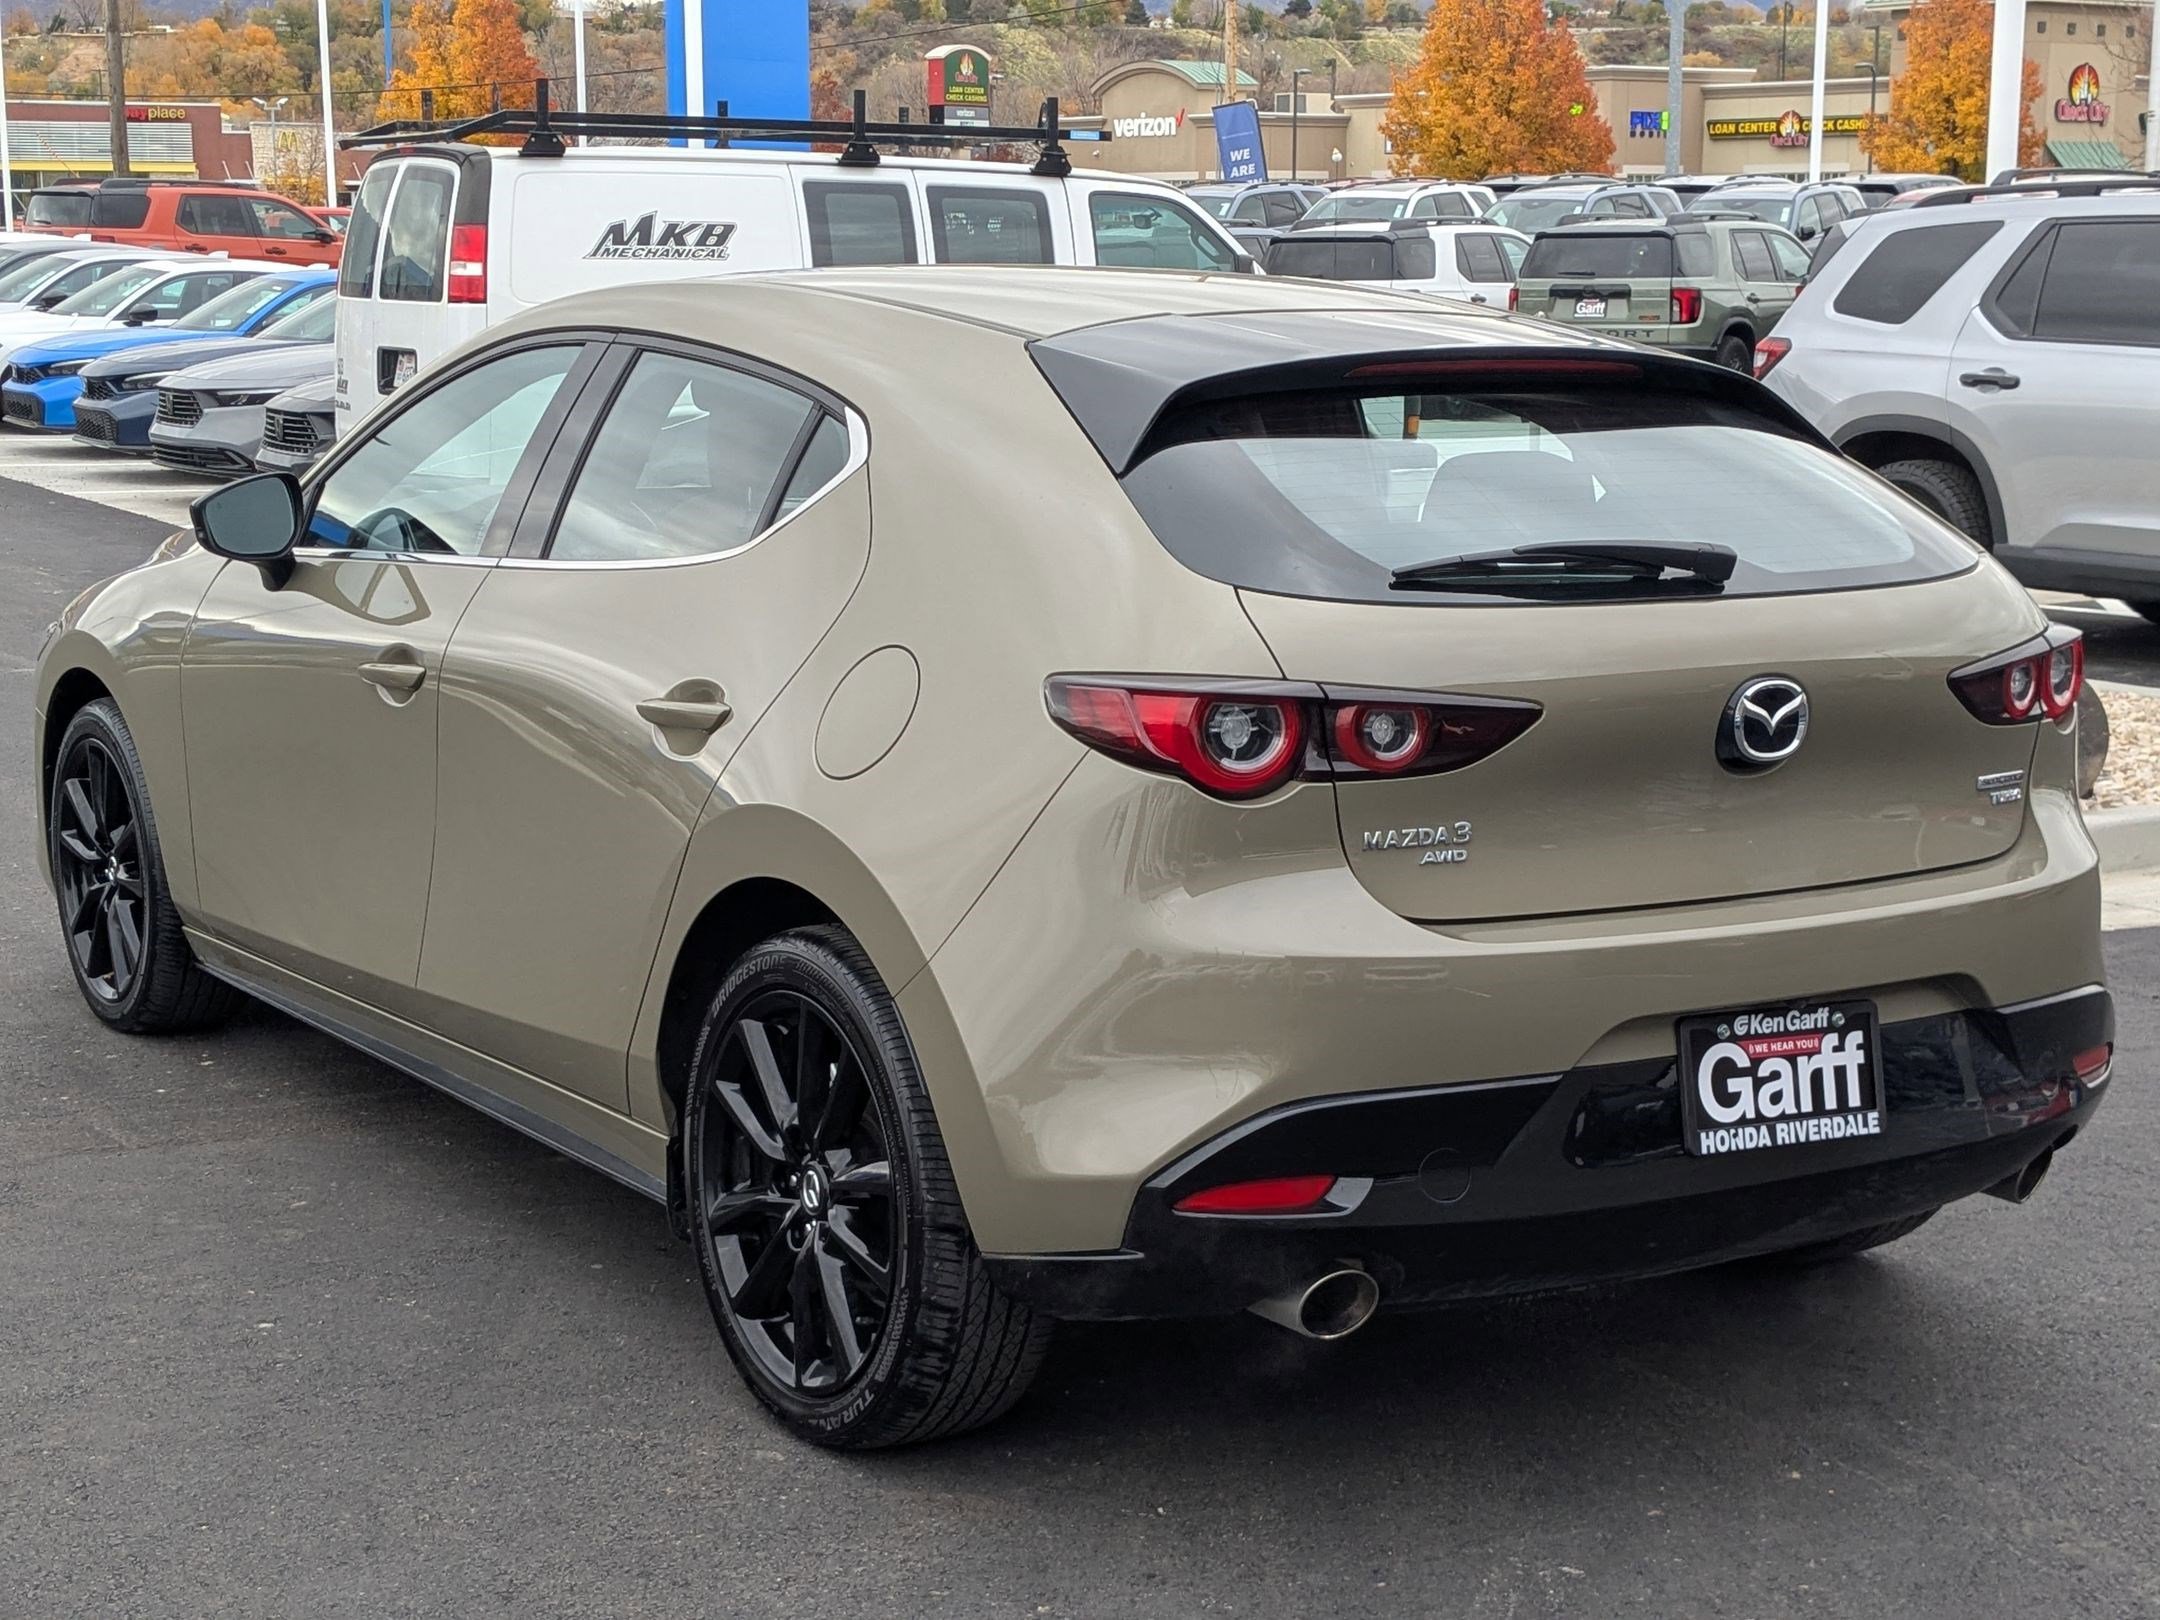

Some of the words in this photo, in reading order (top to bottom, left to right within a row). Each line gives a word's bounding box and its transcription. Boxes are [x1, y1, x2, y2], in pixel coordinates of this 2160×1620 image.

[1113, 112, 1177, 138] verizon
[1709, 124, 1735, 135] LOAN
[1738, 121, 1777, 133] CENTER
[1769, 132, 1792, 147] Check
[1792, 133, 1809, 148] City
[1229, 148, 1251, 162] WE
[1229, 163, 1256, 178] ARE
[584, 211, 738, 259] MKB
[601, 247, 731, 260] MECHANICAL
[1576, 302, 1606, 314] Garff
[1420, 849, 1469, 865] AWD
[1750, 1013, 1784, 1035] Ken
[1786, 1007, 1830, 1032] Garff
[1755, 1043, 1769, 1053] WE
[1771, 1040, 1795, 1051] HEAR
[1796, 1038, 1814, 1049] YOU
[1698, 1030, 1866, 1124] Garff
[1700, 1125, 1772, 1155] HONDA
[1776, 1112, 1881, 1145] RIVERDALE
